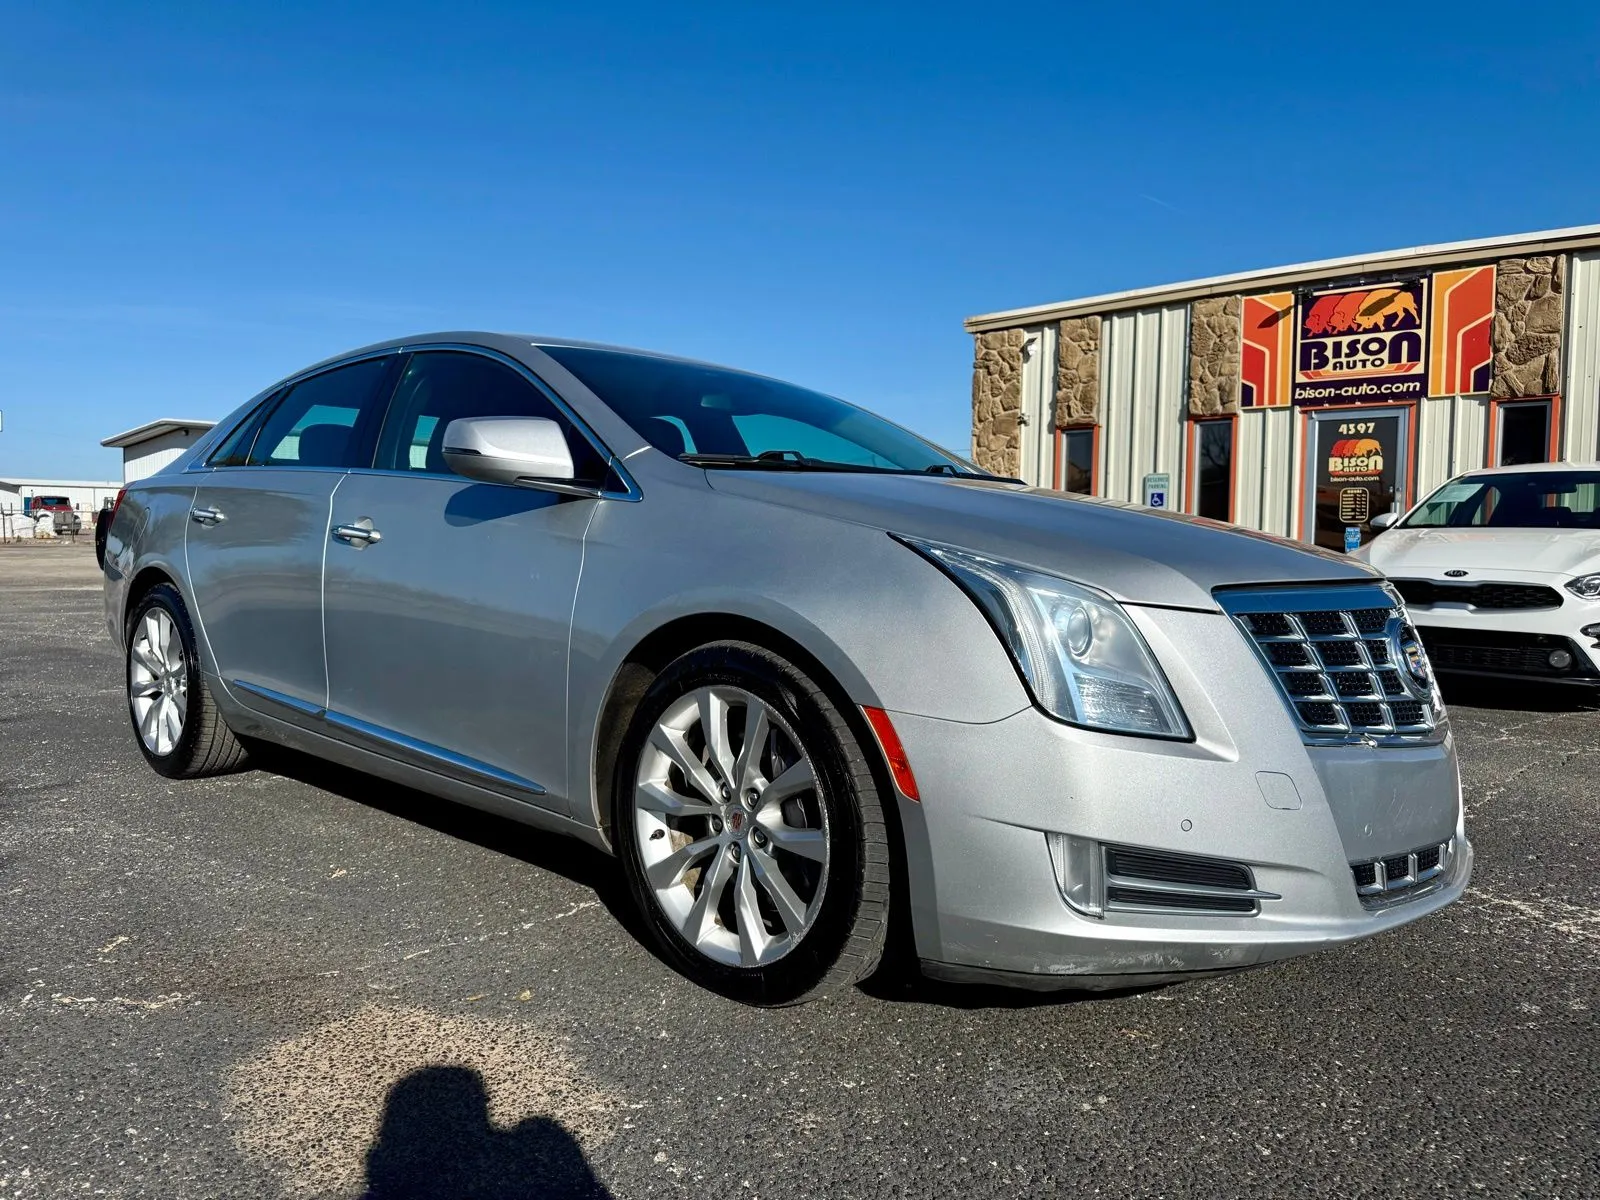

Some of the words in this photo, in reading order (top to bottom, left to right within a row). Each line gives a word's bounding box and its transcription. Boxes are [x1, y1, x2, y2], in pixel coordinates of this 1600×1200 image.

[1299, 332, 1421, 371] BISON
[1332, 358, 1385, 371] AUTO
[1295, 381, 1420, 400] bison-auto.com
[1338, 422, 1376, 435] 4597
[1328, 455, 1384, 472] BISON
[1343, 465, 1368, 473] AUTO
[1330, 475, 1380, 483] bison-auto.com
